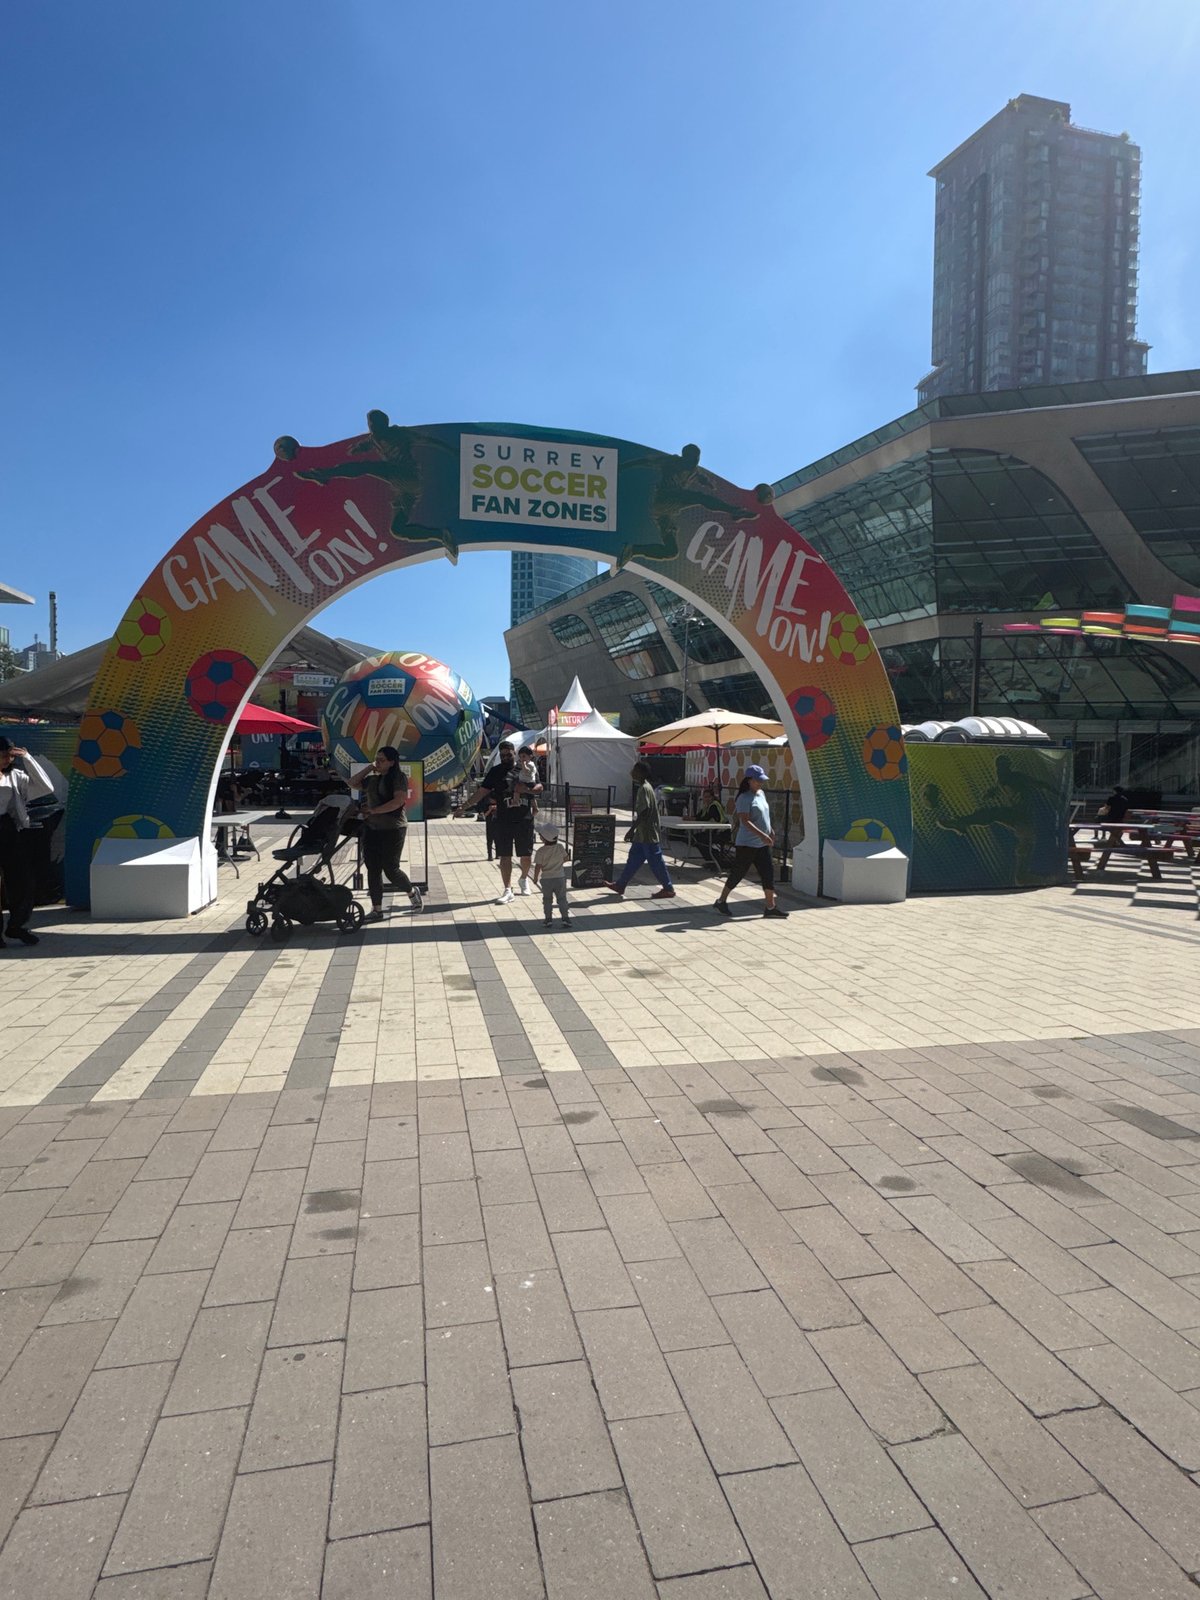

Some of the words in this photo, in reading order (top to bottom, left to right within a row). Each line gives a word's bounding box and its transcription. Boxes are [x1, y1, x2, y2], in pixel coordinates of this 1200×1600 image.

[472, 464, 607, 499] SOCCER
[473, 443, 605, 470] SURREY
[472, 494, 520, 515] FAN
[528, 499, 607, 523] ZONES
[162, 476, 322, 616] GAME
[308, 499, 388, 587] ON!
[686, 521, 822, 637] GAME
[768, 610, 832, 663] ON!
